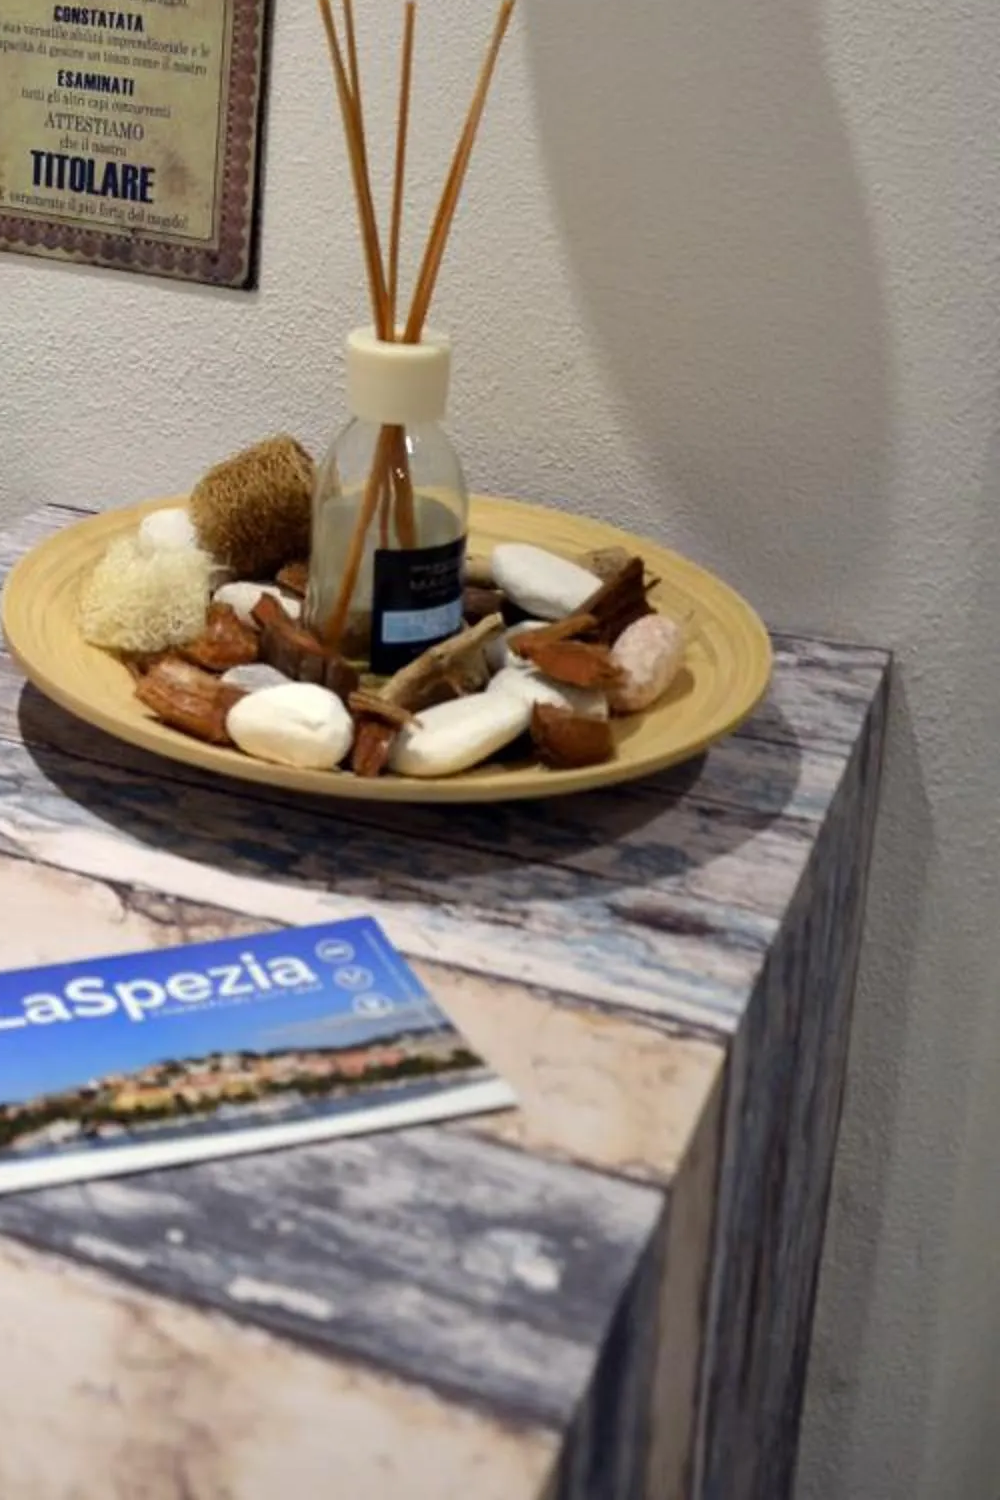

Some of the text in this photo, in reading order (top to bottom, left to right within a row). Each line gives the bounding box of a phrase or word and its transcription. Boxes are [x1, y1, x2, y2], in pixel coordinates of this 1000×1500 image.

[53, 5, 143, 32] CONSTATATA
[57, 69, 135, 96] ESAMINATI
[44, 112, 144, 142] ATTESTIAMO
[60, 136, 77, 150] che
[80, 139, 88, 150] il
[30, 150, 156, 204] TITOLARE
